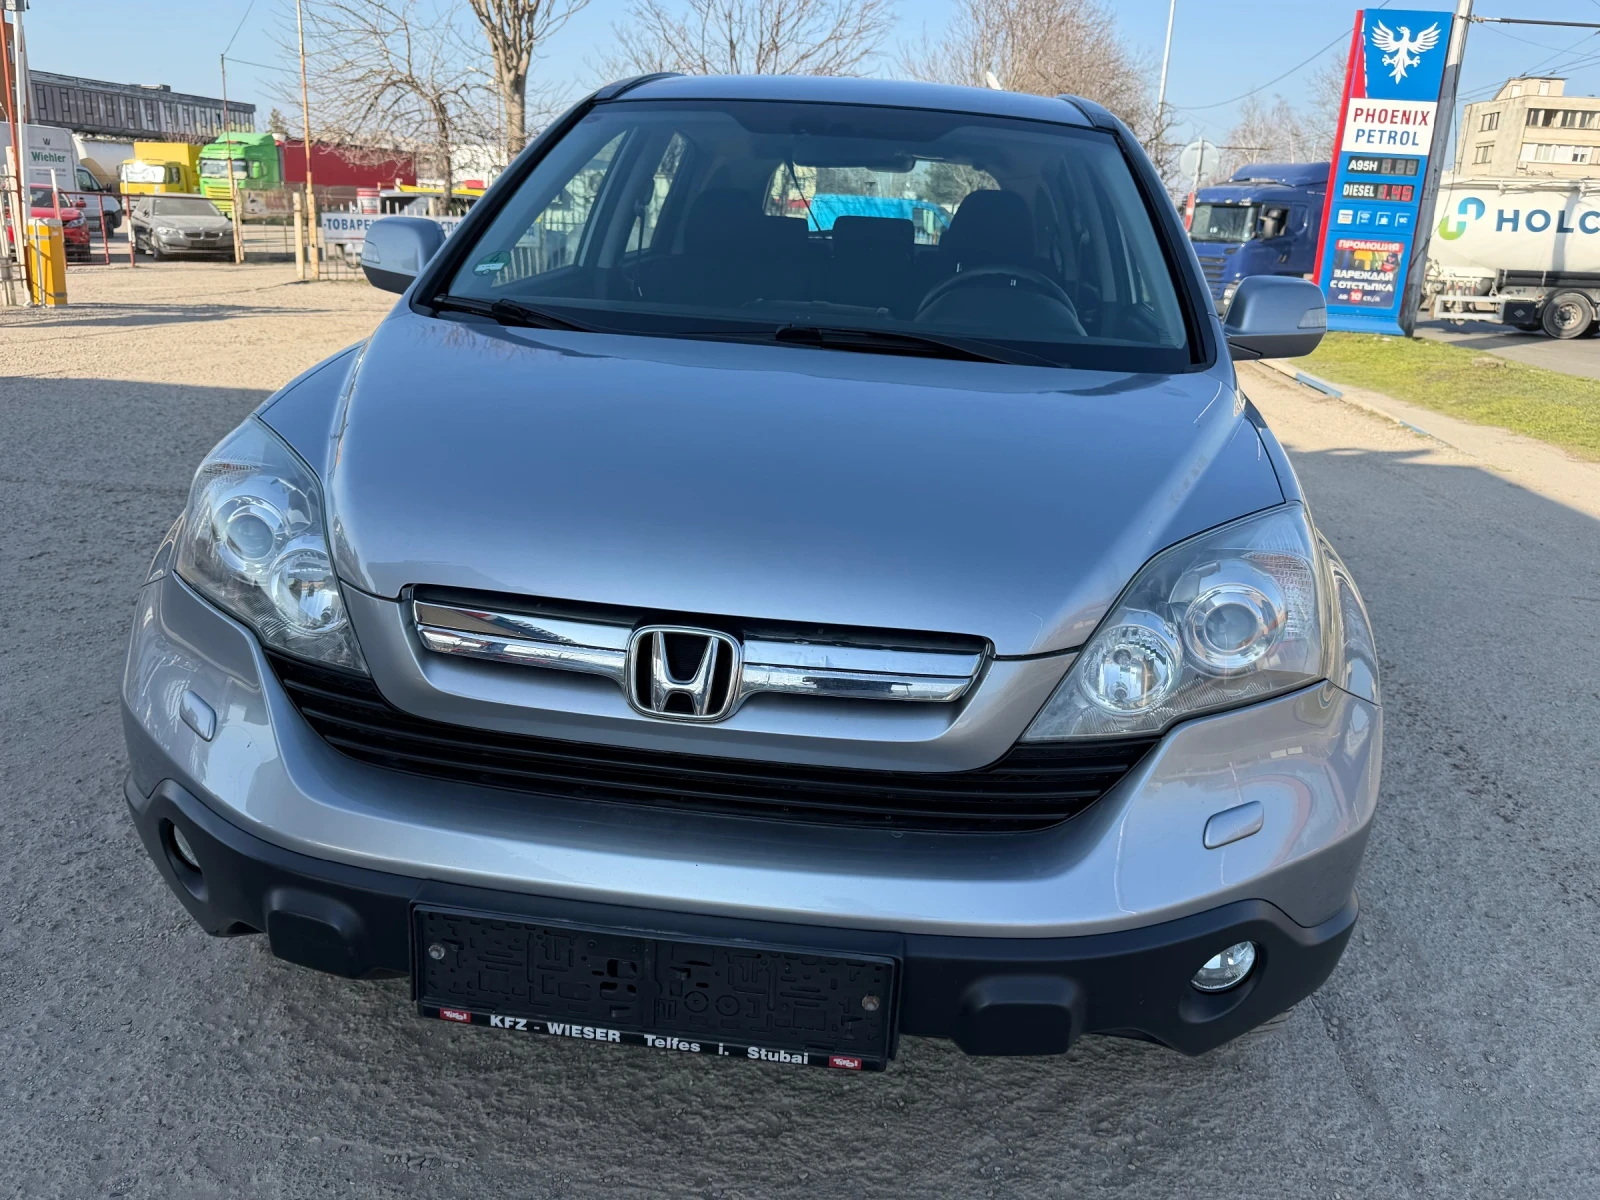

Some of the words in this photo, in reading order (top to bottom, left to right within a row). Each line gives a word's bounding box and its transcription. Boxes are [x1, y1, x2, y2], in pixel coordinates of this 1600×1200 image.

[1353, 107, 1430, 126] PHOENIX
[1355, 129, 1419, 146] PETROL
[31, 151, 66, 163] Wiehler
[1342, 183, 1375, 198] DIESEL
[326, 218, 374, 231] ТОВАРЕ
[1495, 208, 1600, 234] HOLC
[1338, 239, 1400, 251] ПРОМОЦИЯ
[1333, 268, 1394, 282] ЗАРЕЖДАЙ
[1350, 291, 1362, 301] 10
[489, 1014, 528, 1031] KFZ
[546, 1021, 621, 1043] WIESER
[643, 1034, 701, 1053] Telfes
[718, 1043, 730, 1056] i.
[747, 1046, 809, 1065] Stubai
